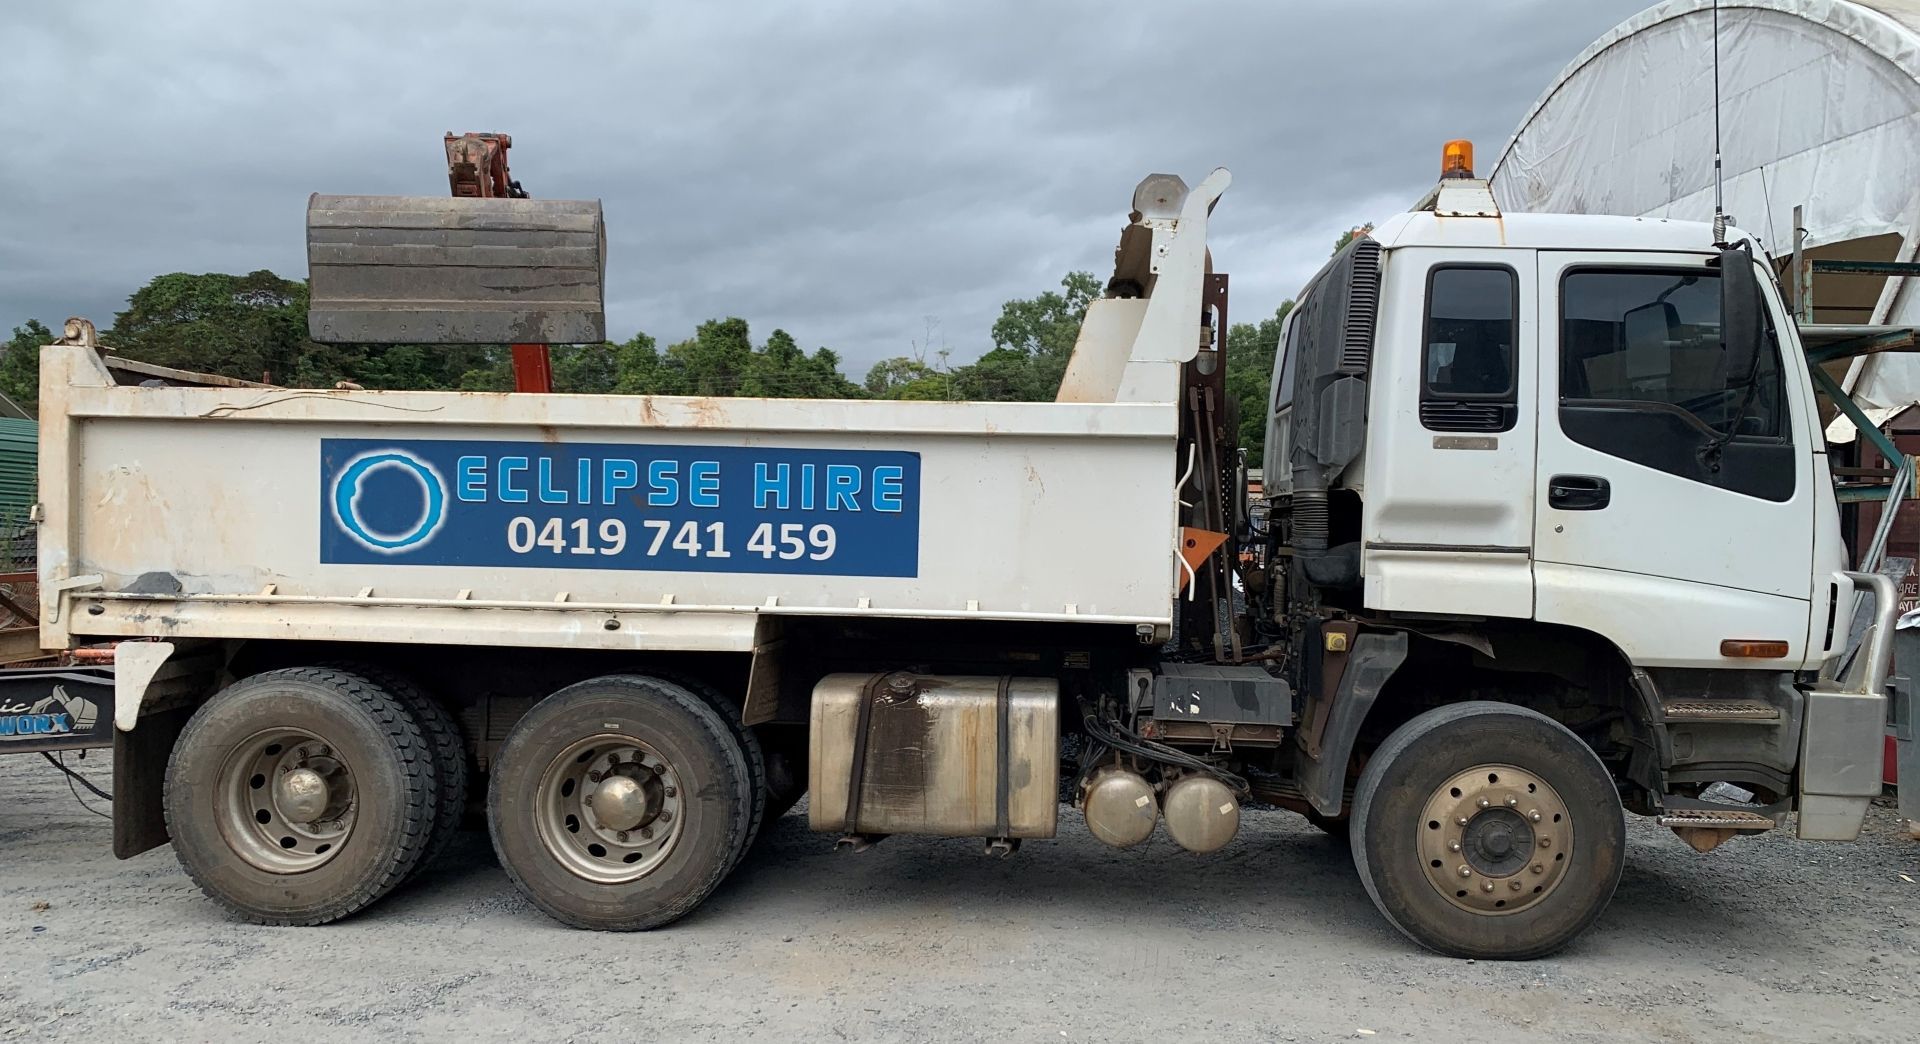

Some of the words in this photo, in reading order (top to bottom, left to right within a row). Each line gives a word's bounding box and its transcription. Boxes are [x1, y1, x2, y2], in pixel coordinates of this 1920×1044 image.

[456, 455, 720, 507] ECLIPSE
[753, 463, 904, 512] HIRE
[507, 516, 626, 556] 0419
[643, 519, 731, 559] 741
[746, 522, 837, 561] 459
